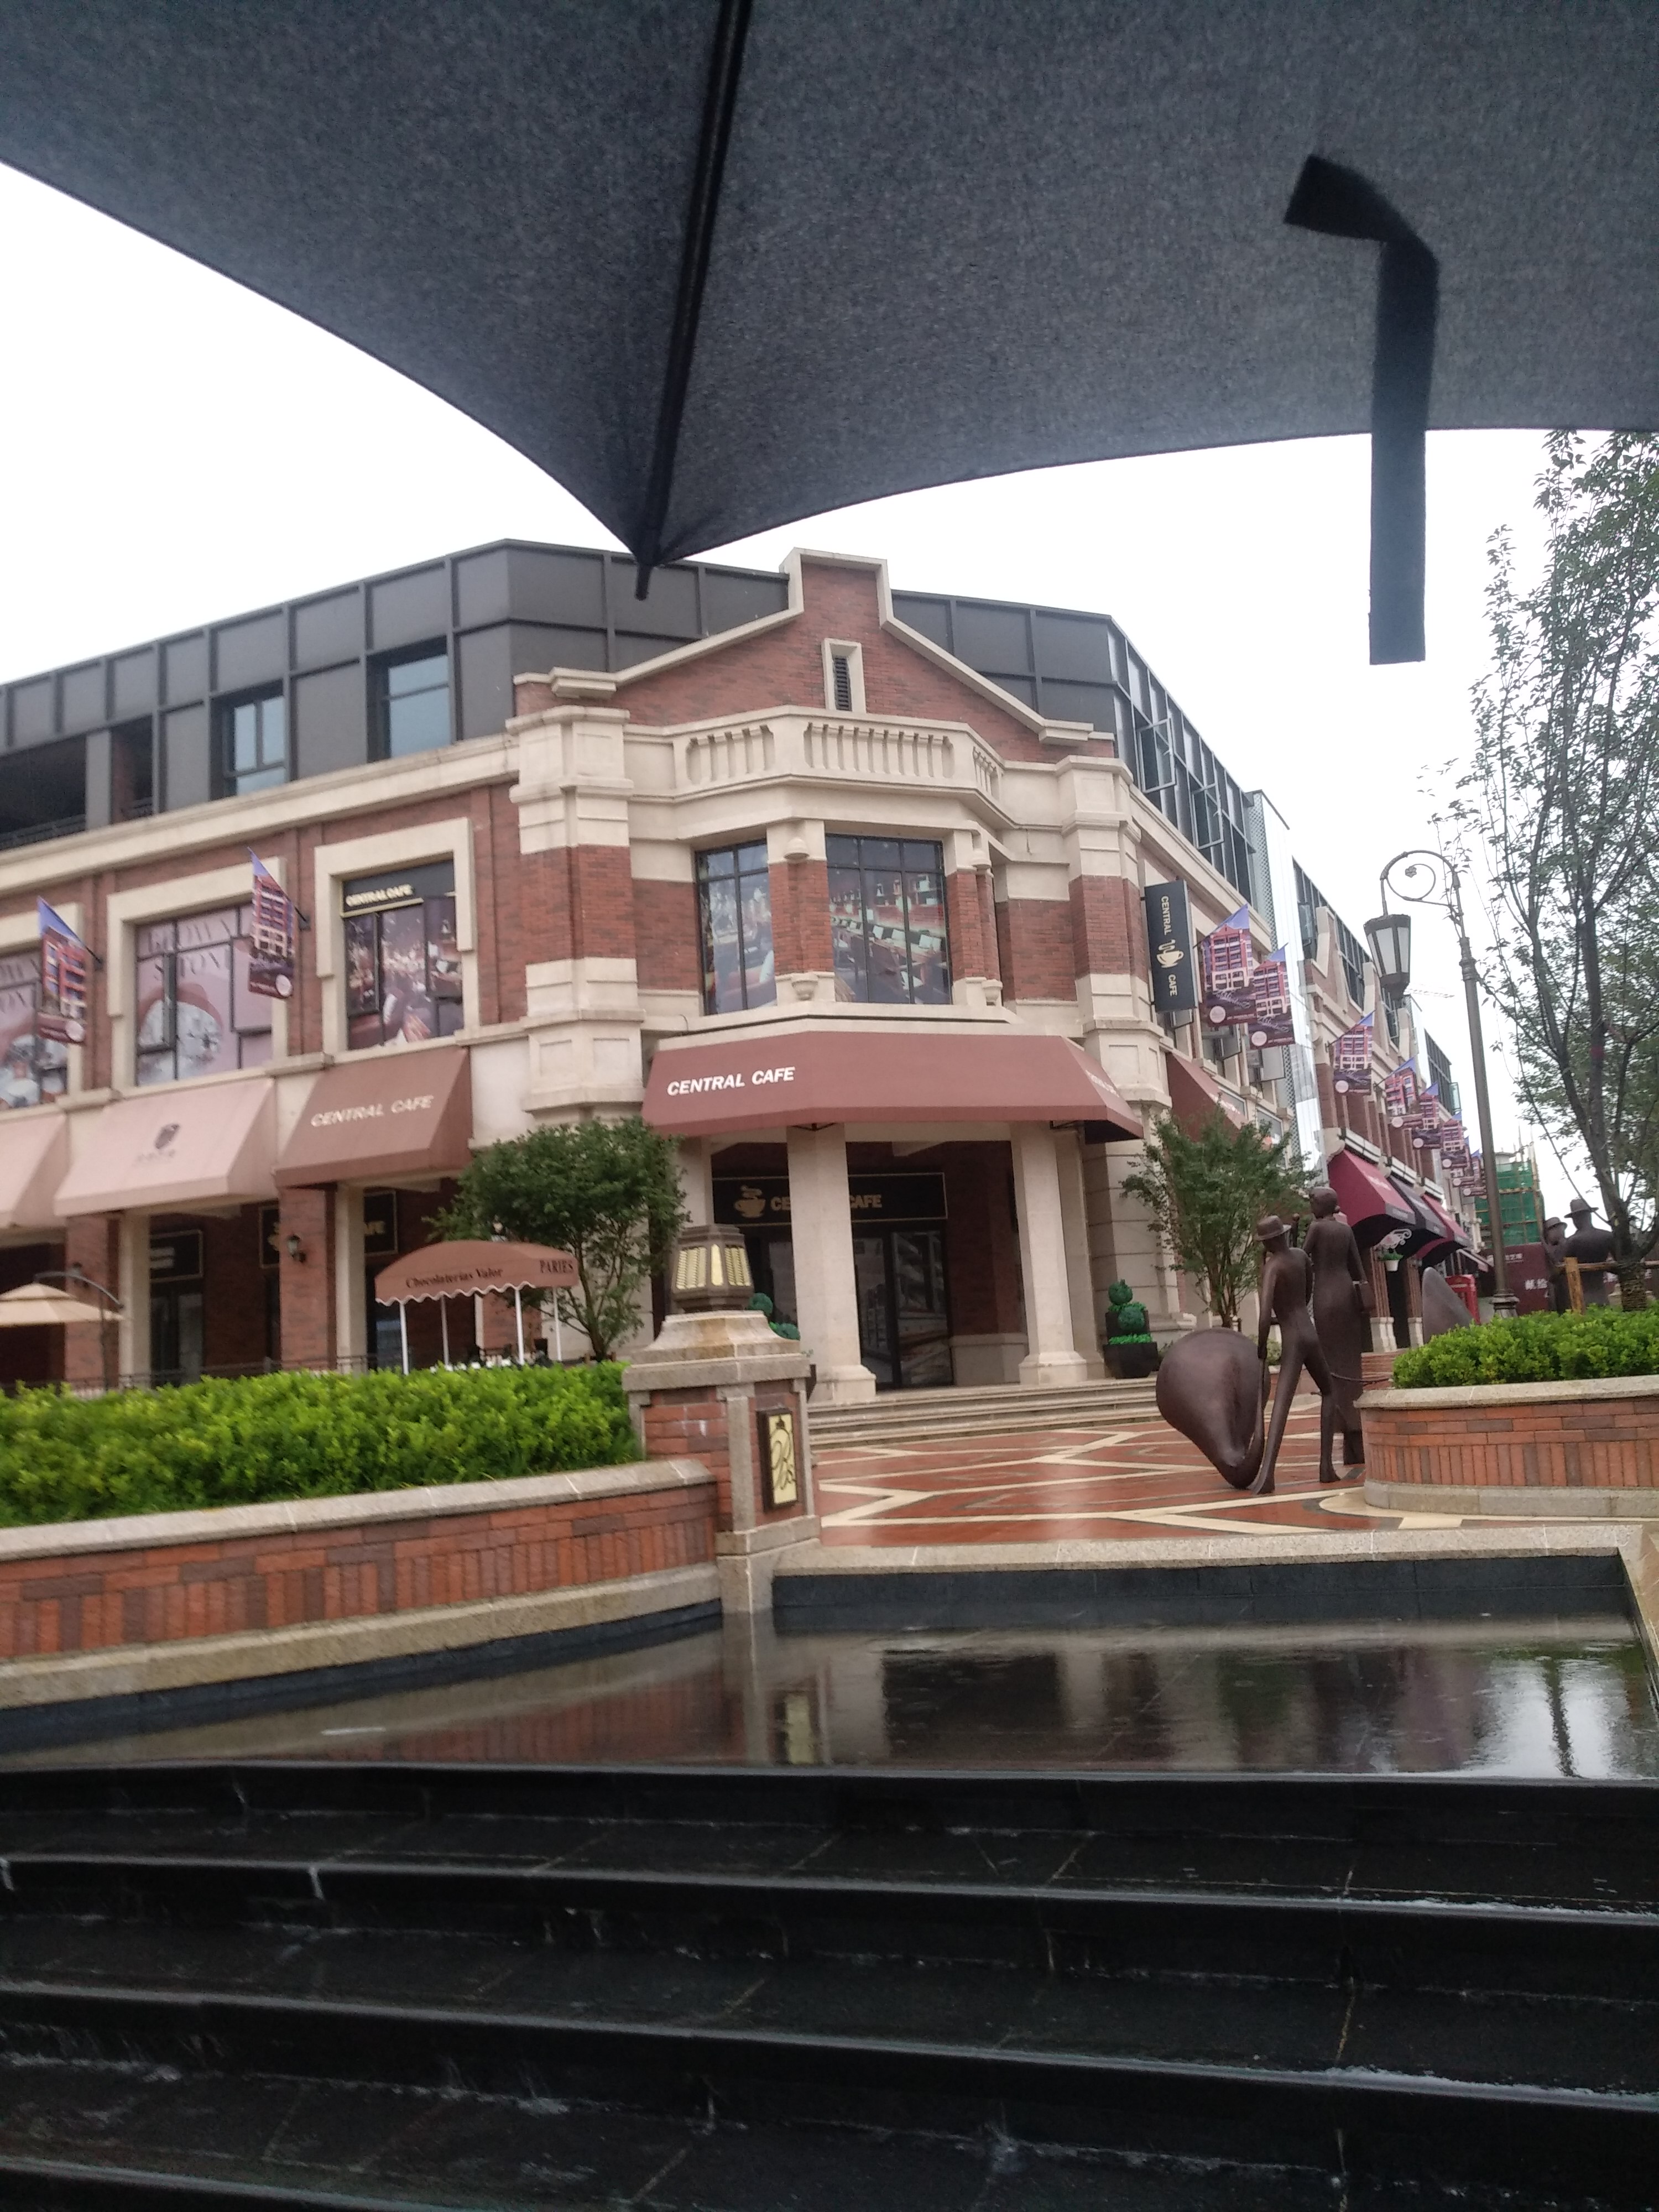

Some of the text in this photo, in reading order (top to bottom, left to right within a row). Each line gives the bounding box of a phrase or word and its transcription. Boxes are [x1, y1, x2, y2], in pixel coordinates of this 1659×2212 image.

[1161, 896, 1171, 936] CENTRAL
[1168, 974, 1177, 997] CAFE
[667, 1066, 796, 1096] CENTRAL CAFE
[311, 1095, 434, 1127] CENTRAL CAFE
